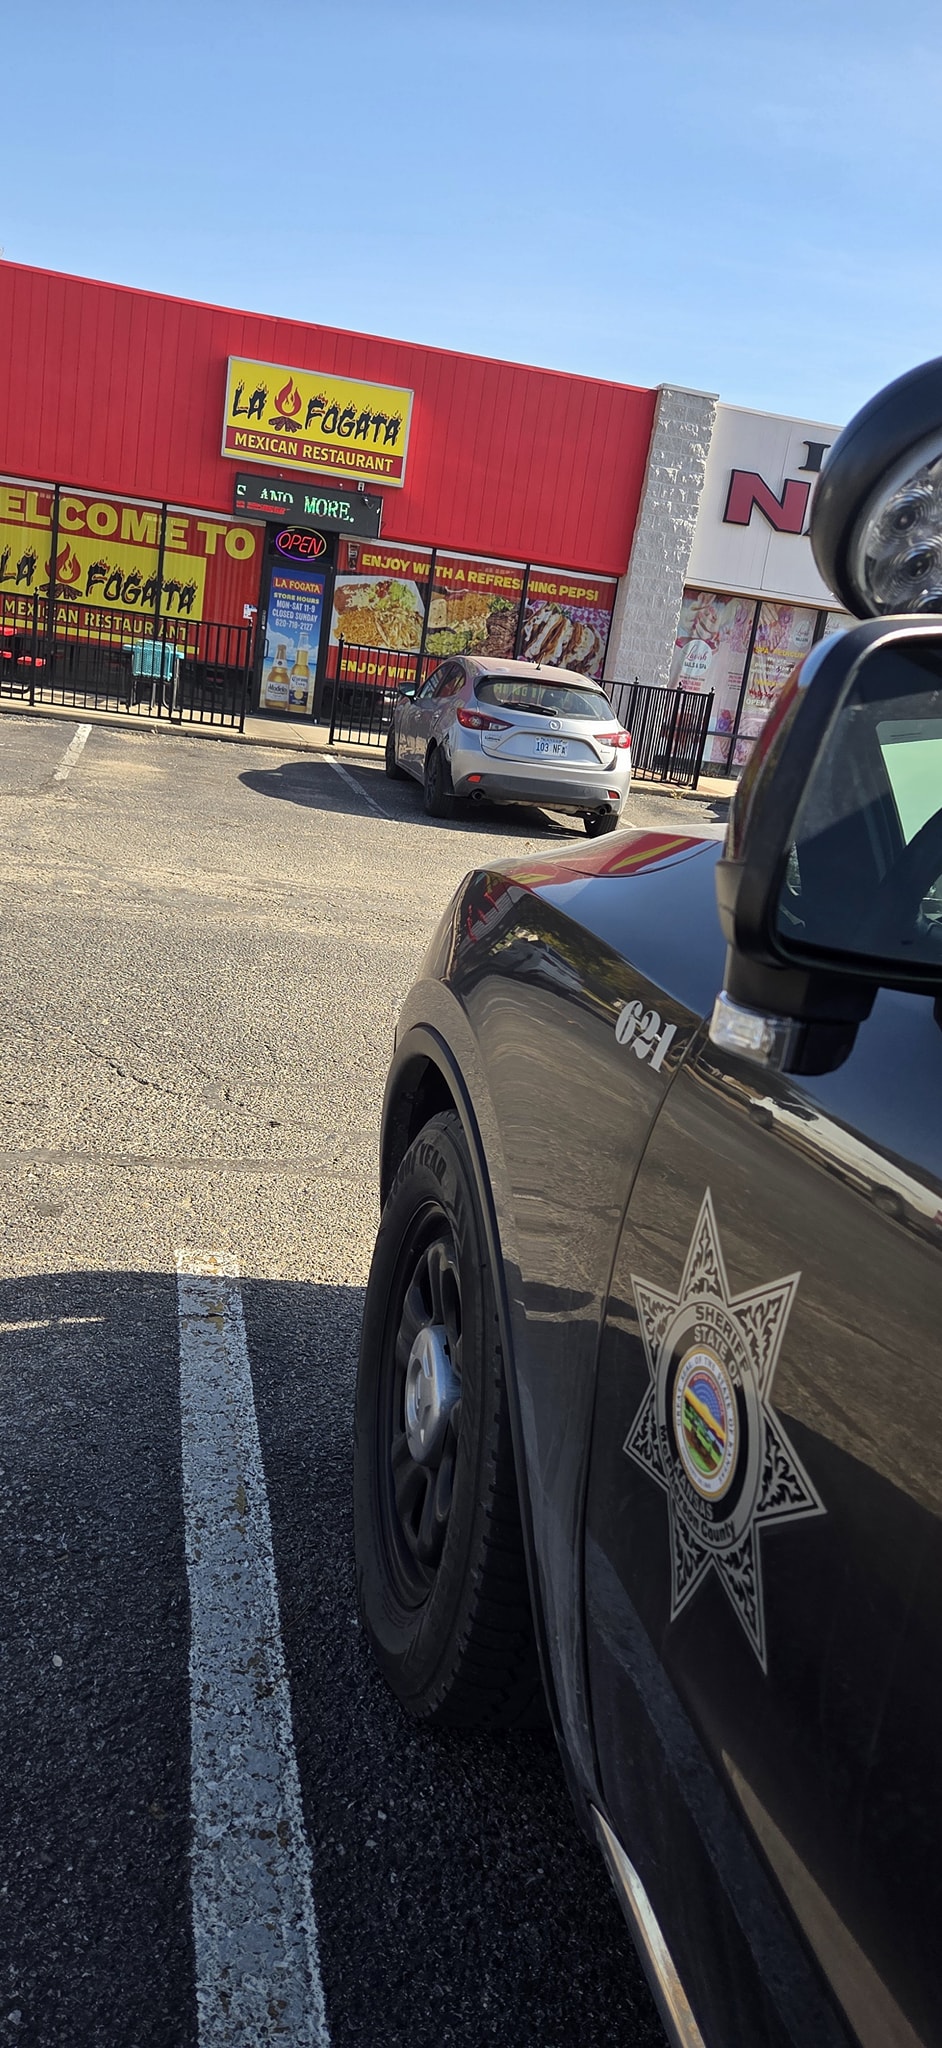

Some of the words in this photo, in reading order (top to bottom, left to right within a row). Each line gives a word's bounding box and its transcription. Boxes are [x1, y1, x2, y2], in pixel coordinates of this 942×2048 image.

[232, 379, 269, 420] LA
[305, 391, 402, 446] FOGATA
[234, 432, 298, 456] MEXICAN
[302, 444, 394, 472] RESTAURANT
[722, 469, 811, 536] N
[0, 487, 189, 550] ELCOME
[197, 522, 256, 560] TO
[278, 532, 323, 555] OPEN
[0, 544, 39, 587] LA
[85, 556, 199, 614] FOGATA
[275, 578, 288, 589] LA
[289, 580, 321, 594] FOGATA
[361, 553, 411, 572] ENJOY
[412, 562, 454, 580] WITH
[454, 569, 465, 581] A
[467, 570, 557, 595] REFRESHING
[558, 584, 599, 602] PEPSI
[4, 599, 79, 624] MEXIAN
[272, 608, 294, 619] CLOSED
[294, 612, 318, 623] SUNDAY
[273, 592, 296, 601] STORE
[296, 595, 320, 605] HOURS
[276, 600, 303, 611] MON-SAT
[340, 659, 386, 676] ENJOY
[536, 741, 549, 752] 103
[615, 1000, 678, 1073] 621
[693, 1326, 728, 1360] STATE
[728, 1360, 742, 1390] OF
[695, 1305, 751, 1372] SHERIFF
[673, 1457, 714, 1521] KANSAS
[701, 1521, 735, 1542] County
